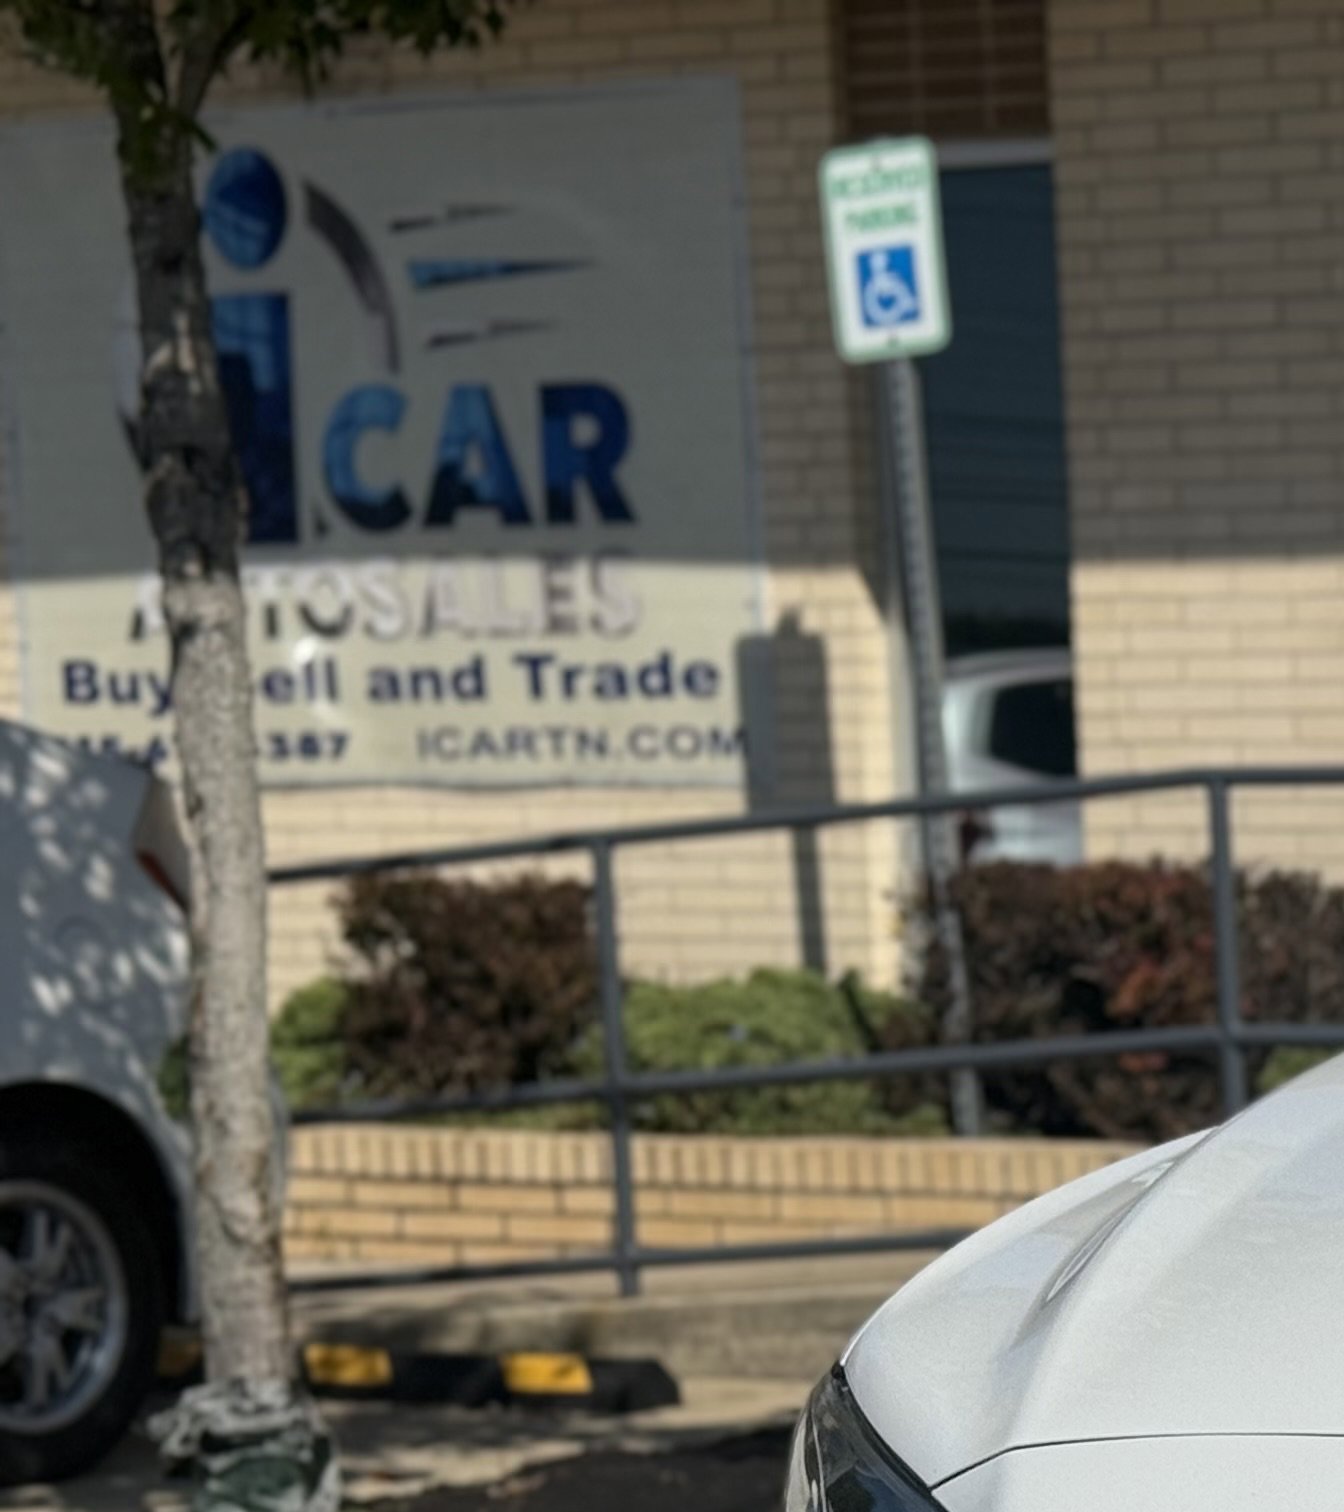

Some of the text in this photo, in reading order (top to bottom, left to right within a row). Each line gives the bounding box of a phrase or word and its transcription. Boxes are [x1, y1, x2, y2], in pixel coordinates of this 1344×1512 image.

[63, 652, 722, 715] Buy ell and Trade
[416, 725, 748, 762] ICARTN.COM
